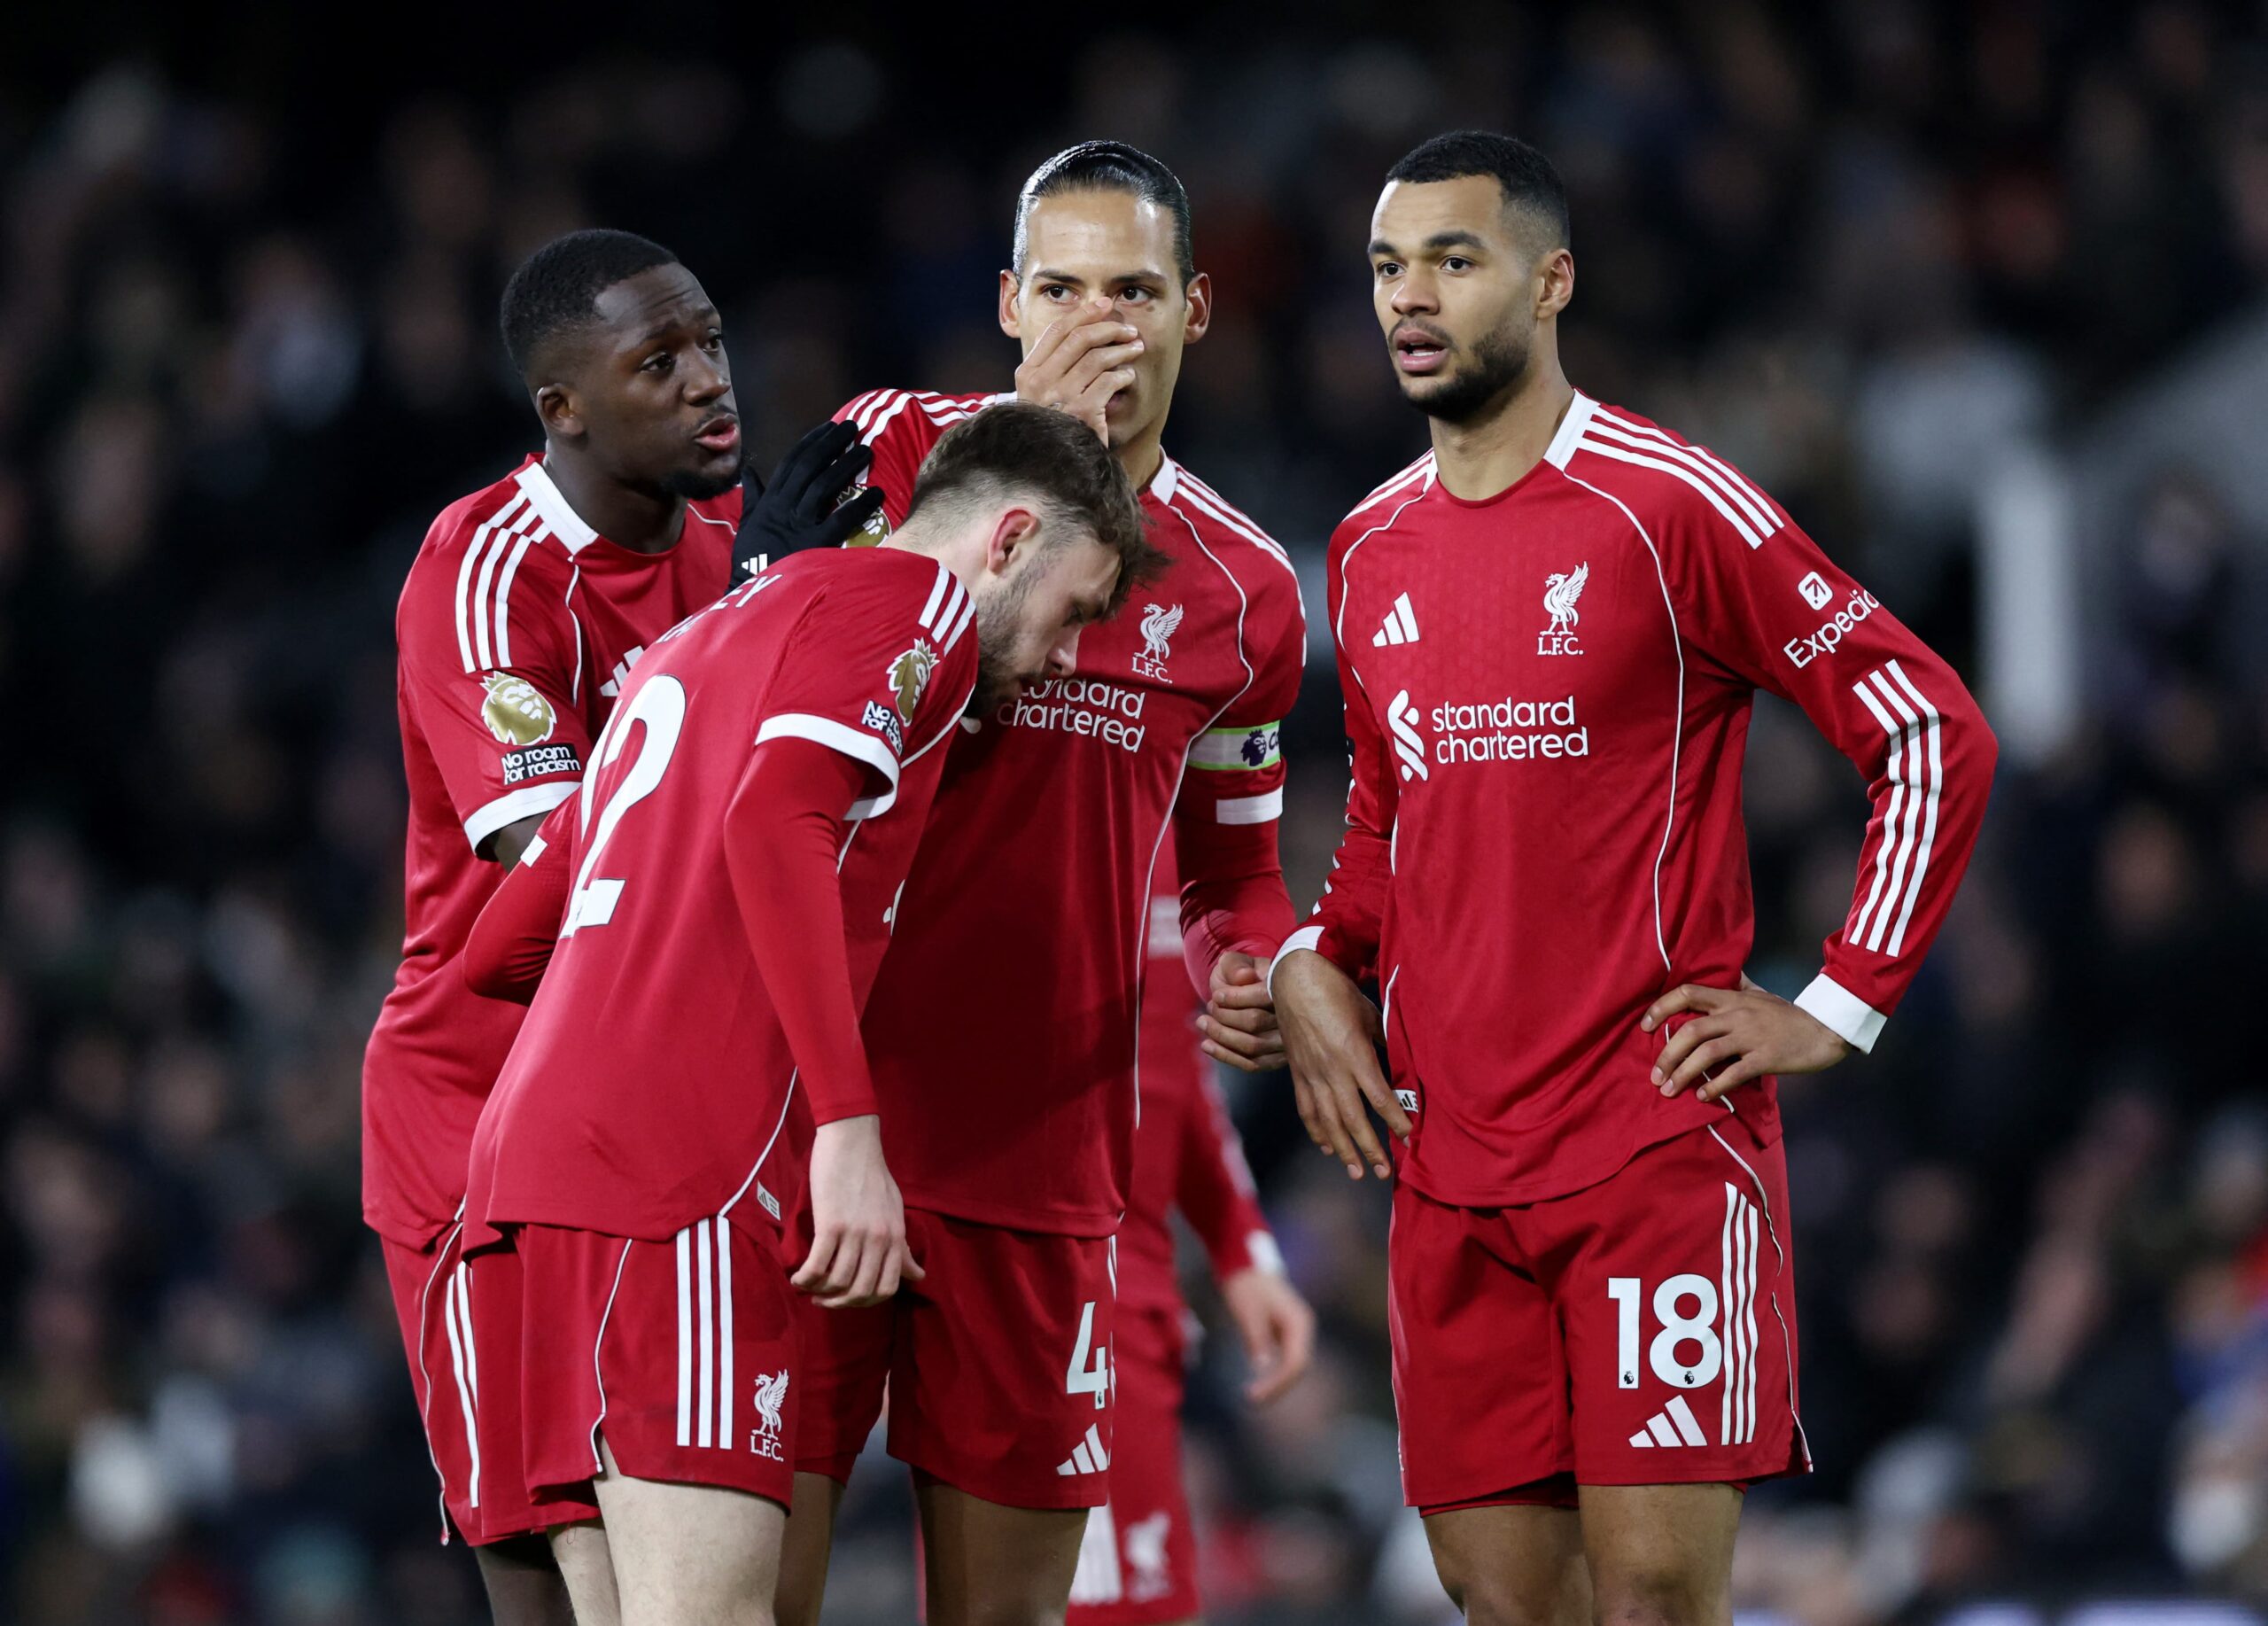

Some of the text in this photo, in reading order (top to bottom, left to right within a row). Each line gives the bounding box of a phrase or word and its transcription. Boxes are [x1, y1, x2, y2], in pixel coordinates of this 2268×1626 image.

[1537, 637, 1584, 656] L.F.C.
[1131, 657, 1173, 684] L.F.C.
[865, 700, 890, 721] No
[1432, 696, 1575, 733] standard
[997, 699, 1146, 753] chartered
[501, 746, 571, 769] No room
[1436, 727, 1588, 765] chartered
[527, 759, 581, 777] racism
[1608, 1273, 1722, 1389] 18
[1067, 1302, 1108, 1410] 4
[750, 1435, 784, 1462] L.F.C.
